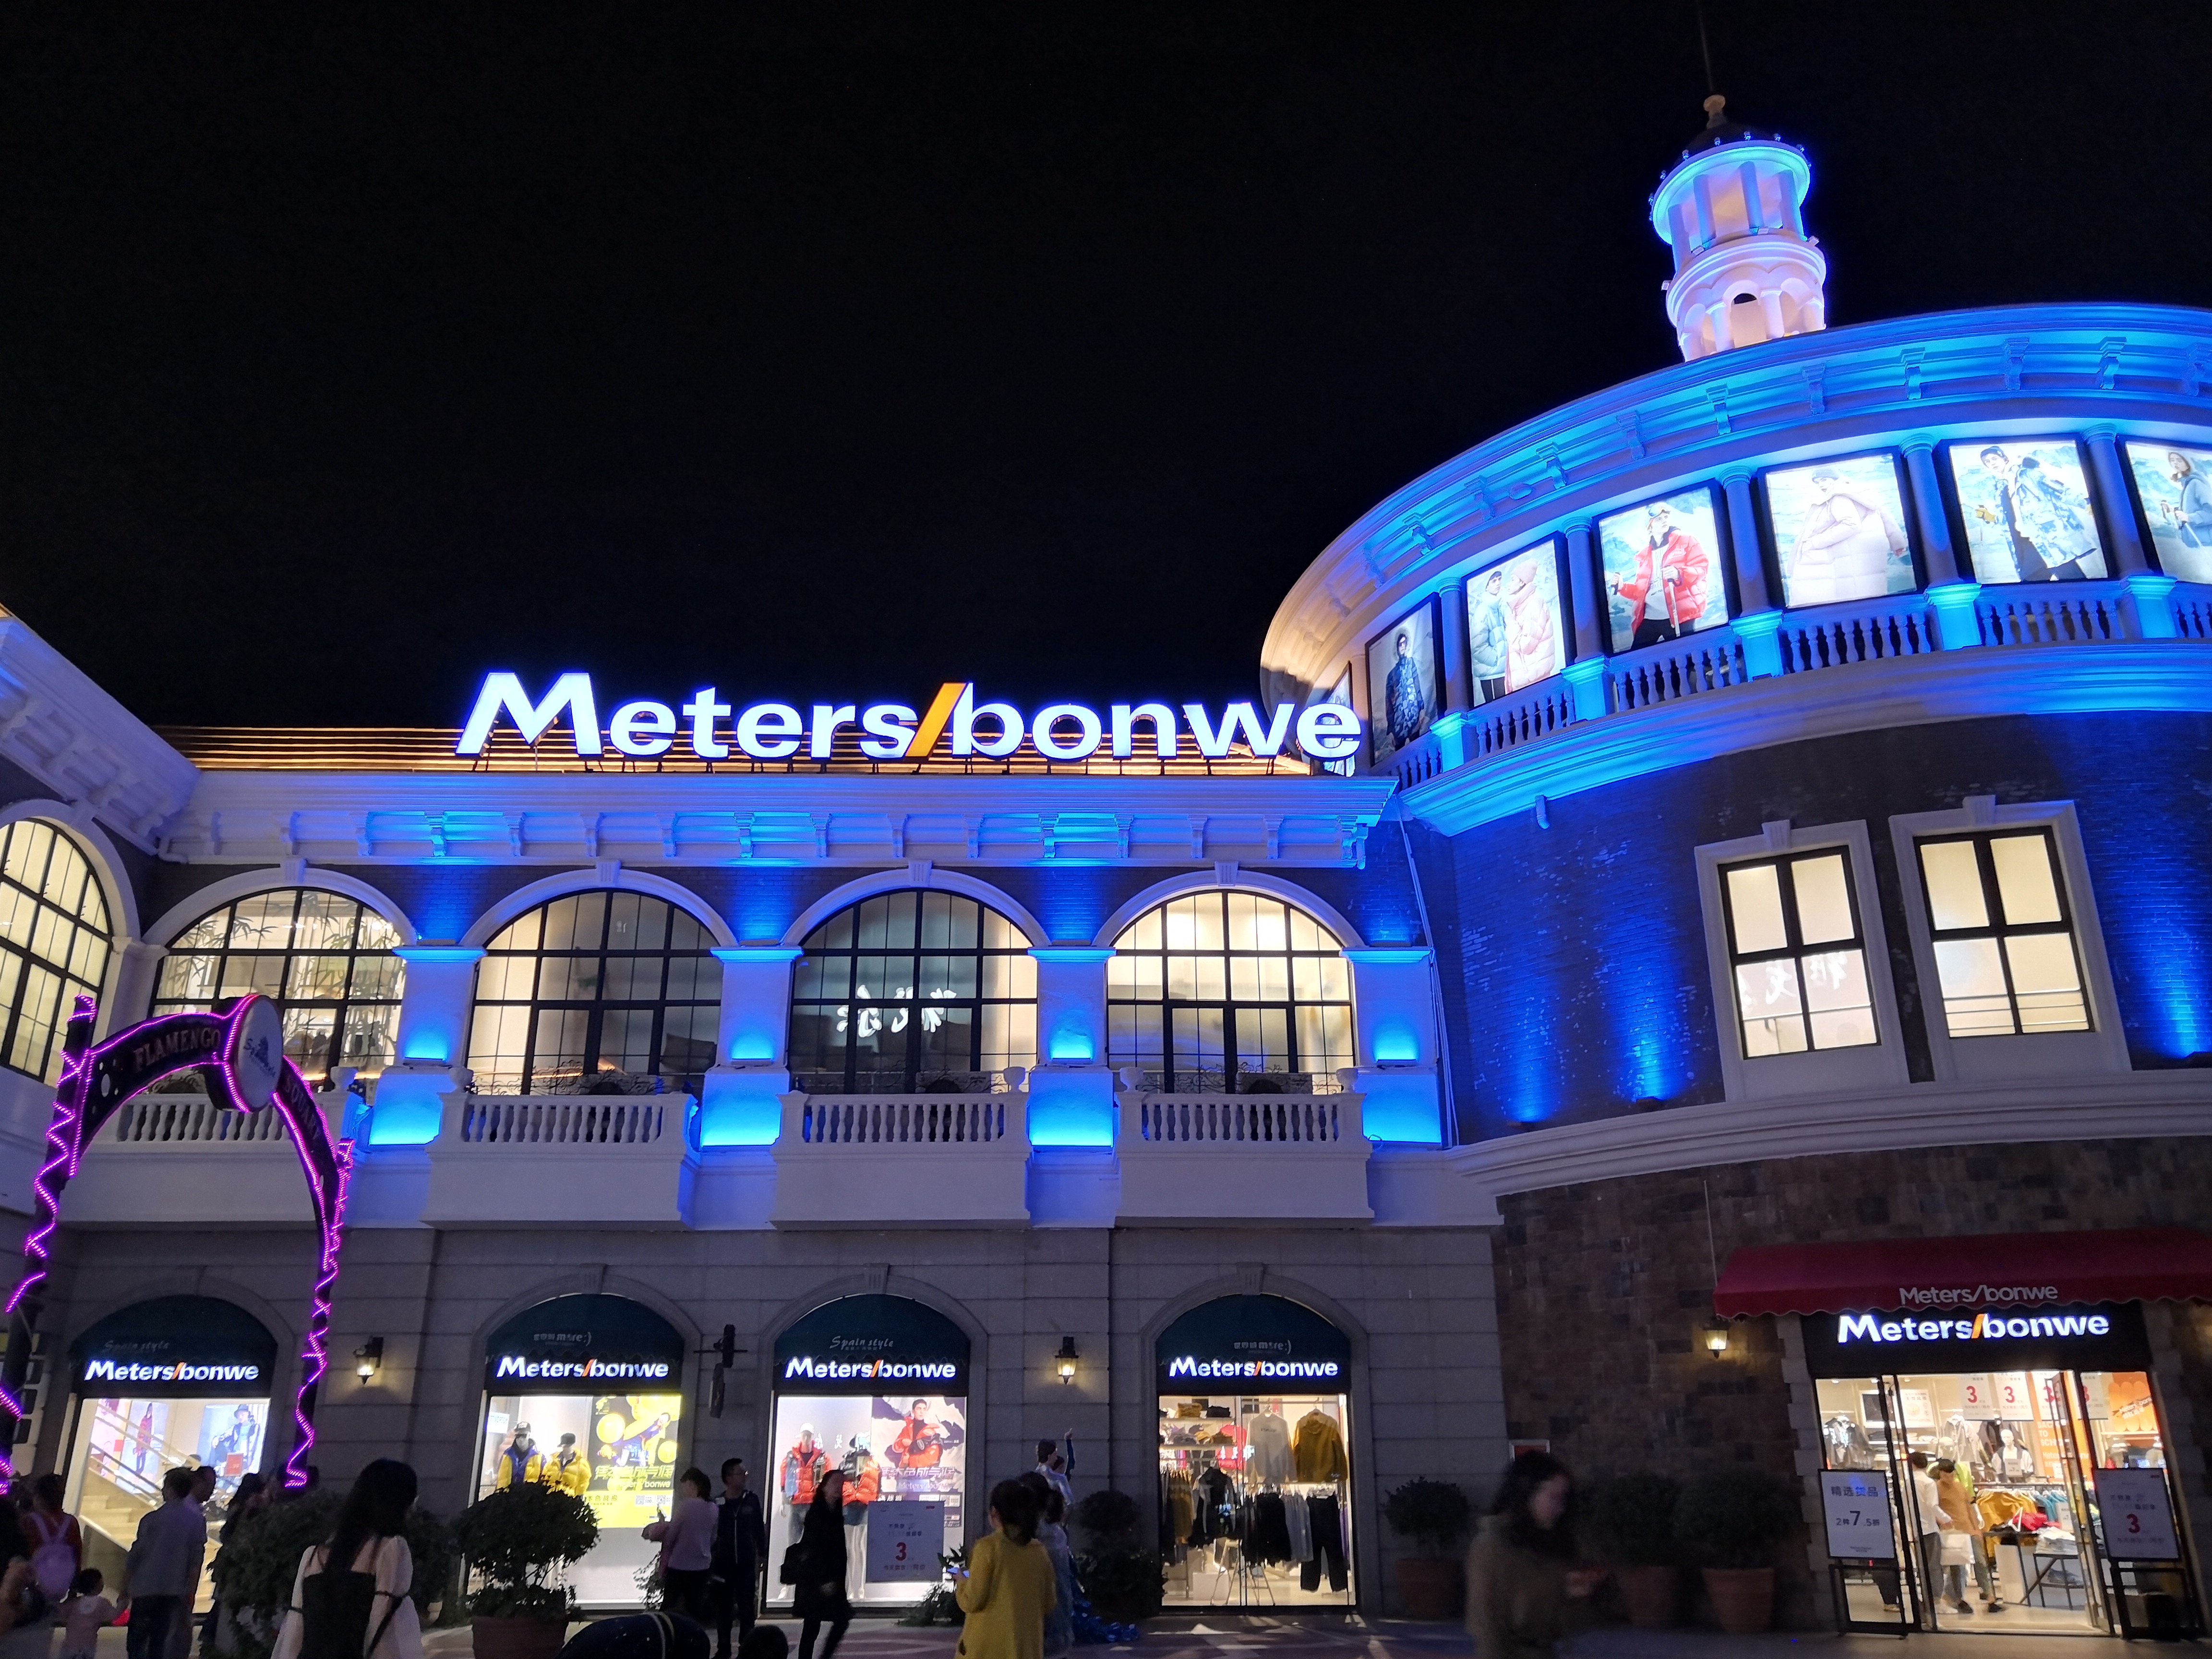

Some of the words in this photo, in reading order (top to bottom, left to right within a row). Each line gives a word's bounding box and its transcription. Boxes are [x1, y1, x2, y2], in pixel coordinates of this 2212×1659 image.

[456, 672, 1361, 758] Meters/bonwe
[1899, 1285, 2058, 1305] Meters/bonwe
[1838, 1313, 2110, 1343] Meters/bonwe
[868, 1338, 895, 1350] style
[84, 1360, 259, 1381] Meters/bonwe
[496, 1355, 669, 1378] Meters/bonwe
[785, 1356, 956, 1378] Meters/bonwe
[1169, 1355, 1338, 1377] Meters/bonwe
[1966, 1385, 1978, 1403] 3
[2004, 1386, 2016, 1403] 3
[1831, 1486, 1878, 1497] 精选货品
[2126, 1514, 2140, 1533] 3
[895, 1542, 907, 1561] 3
